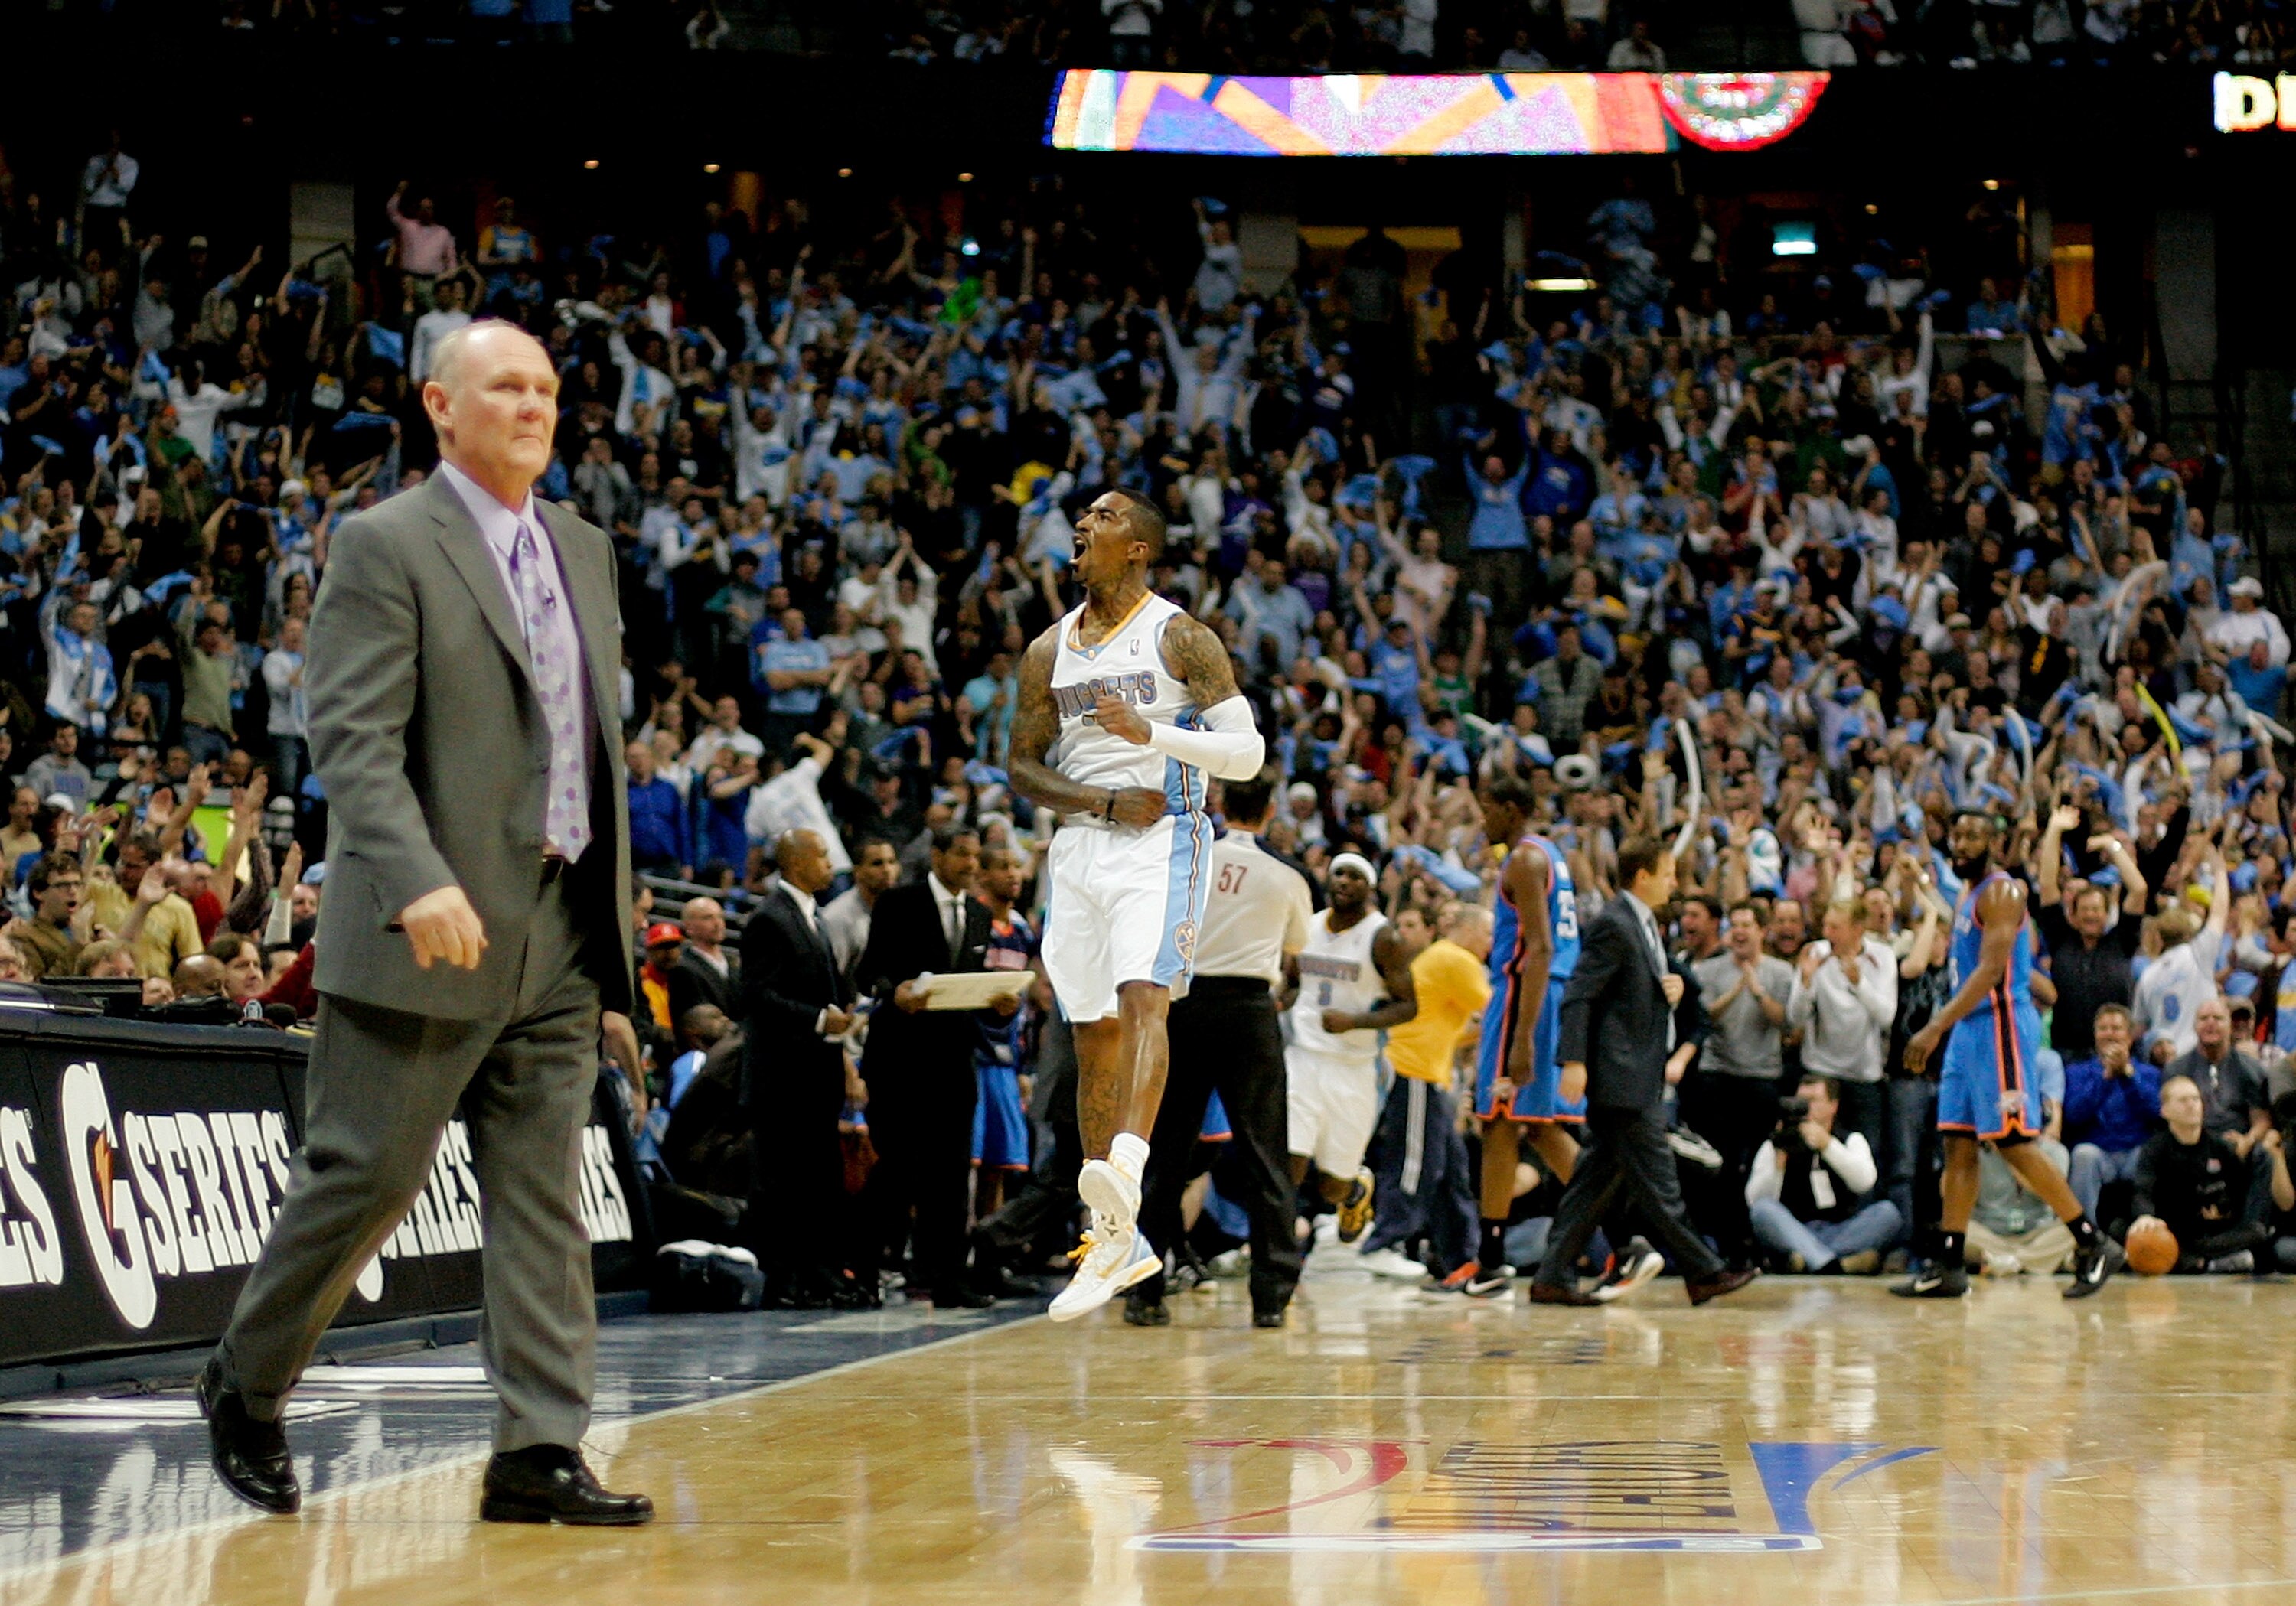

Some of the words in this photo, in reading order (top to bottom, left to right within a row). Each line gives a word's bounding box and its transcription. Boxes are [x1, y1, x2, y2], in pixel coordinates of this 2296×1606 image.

[1218, 862, 1248, 894] 57
[61, 1062, 157, 1329] G
[123, 1110, 292, 1277] SERIES
